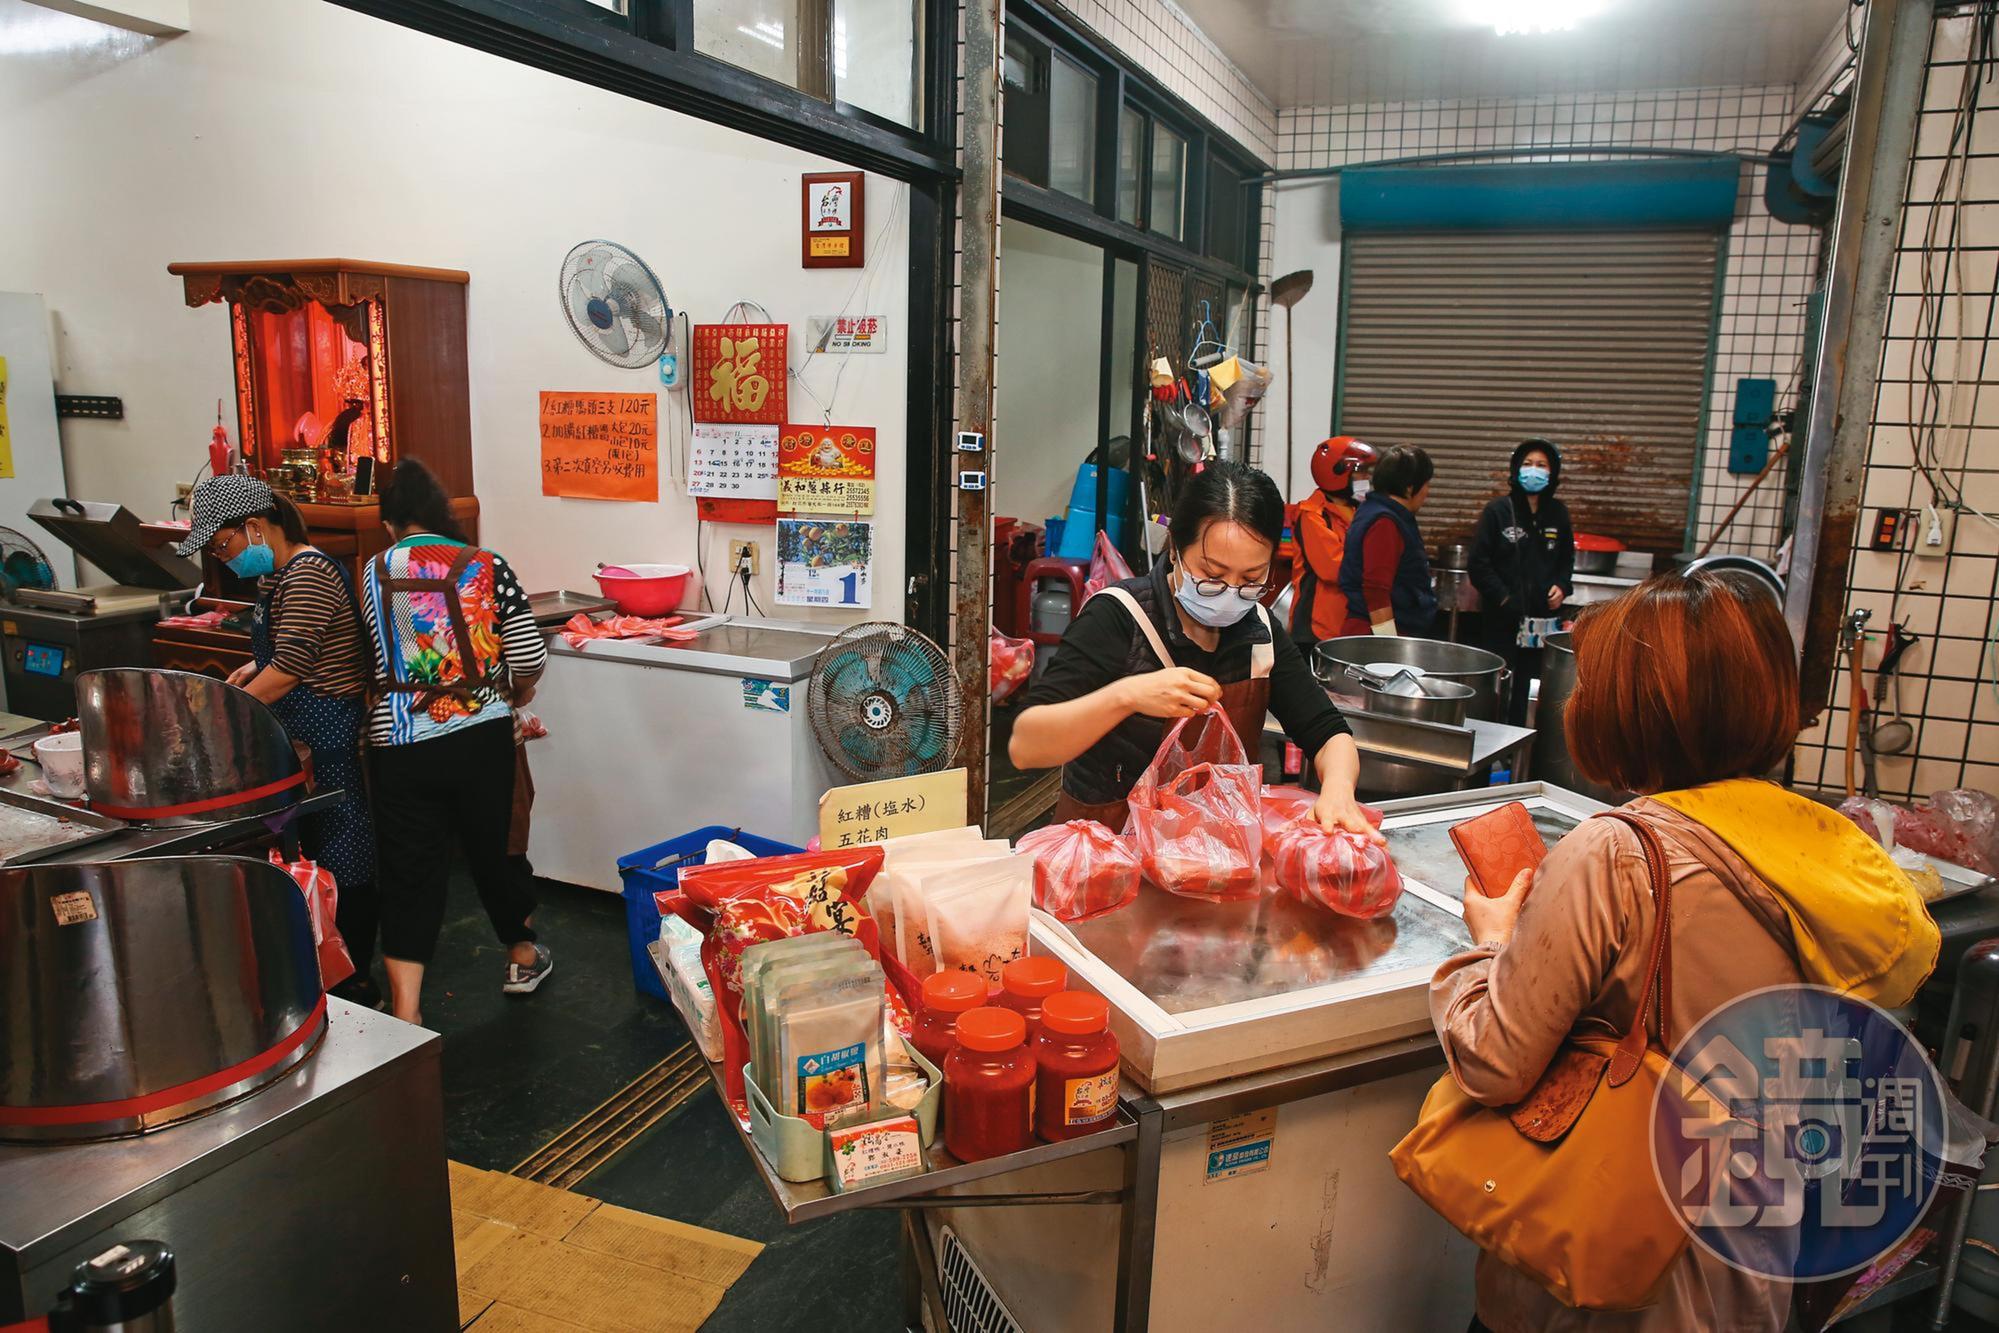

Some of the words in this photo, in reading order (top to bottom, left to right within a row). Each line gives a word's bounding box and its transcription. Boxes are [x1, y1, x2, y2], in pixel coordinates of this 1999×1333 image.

[710, 337, 769, 413] 福
[839, 573, 860, 604] 1
[837, 794, 926, 823] 紅糟(塩水)
[838, 827, 888, 848] 五花肉
